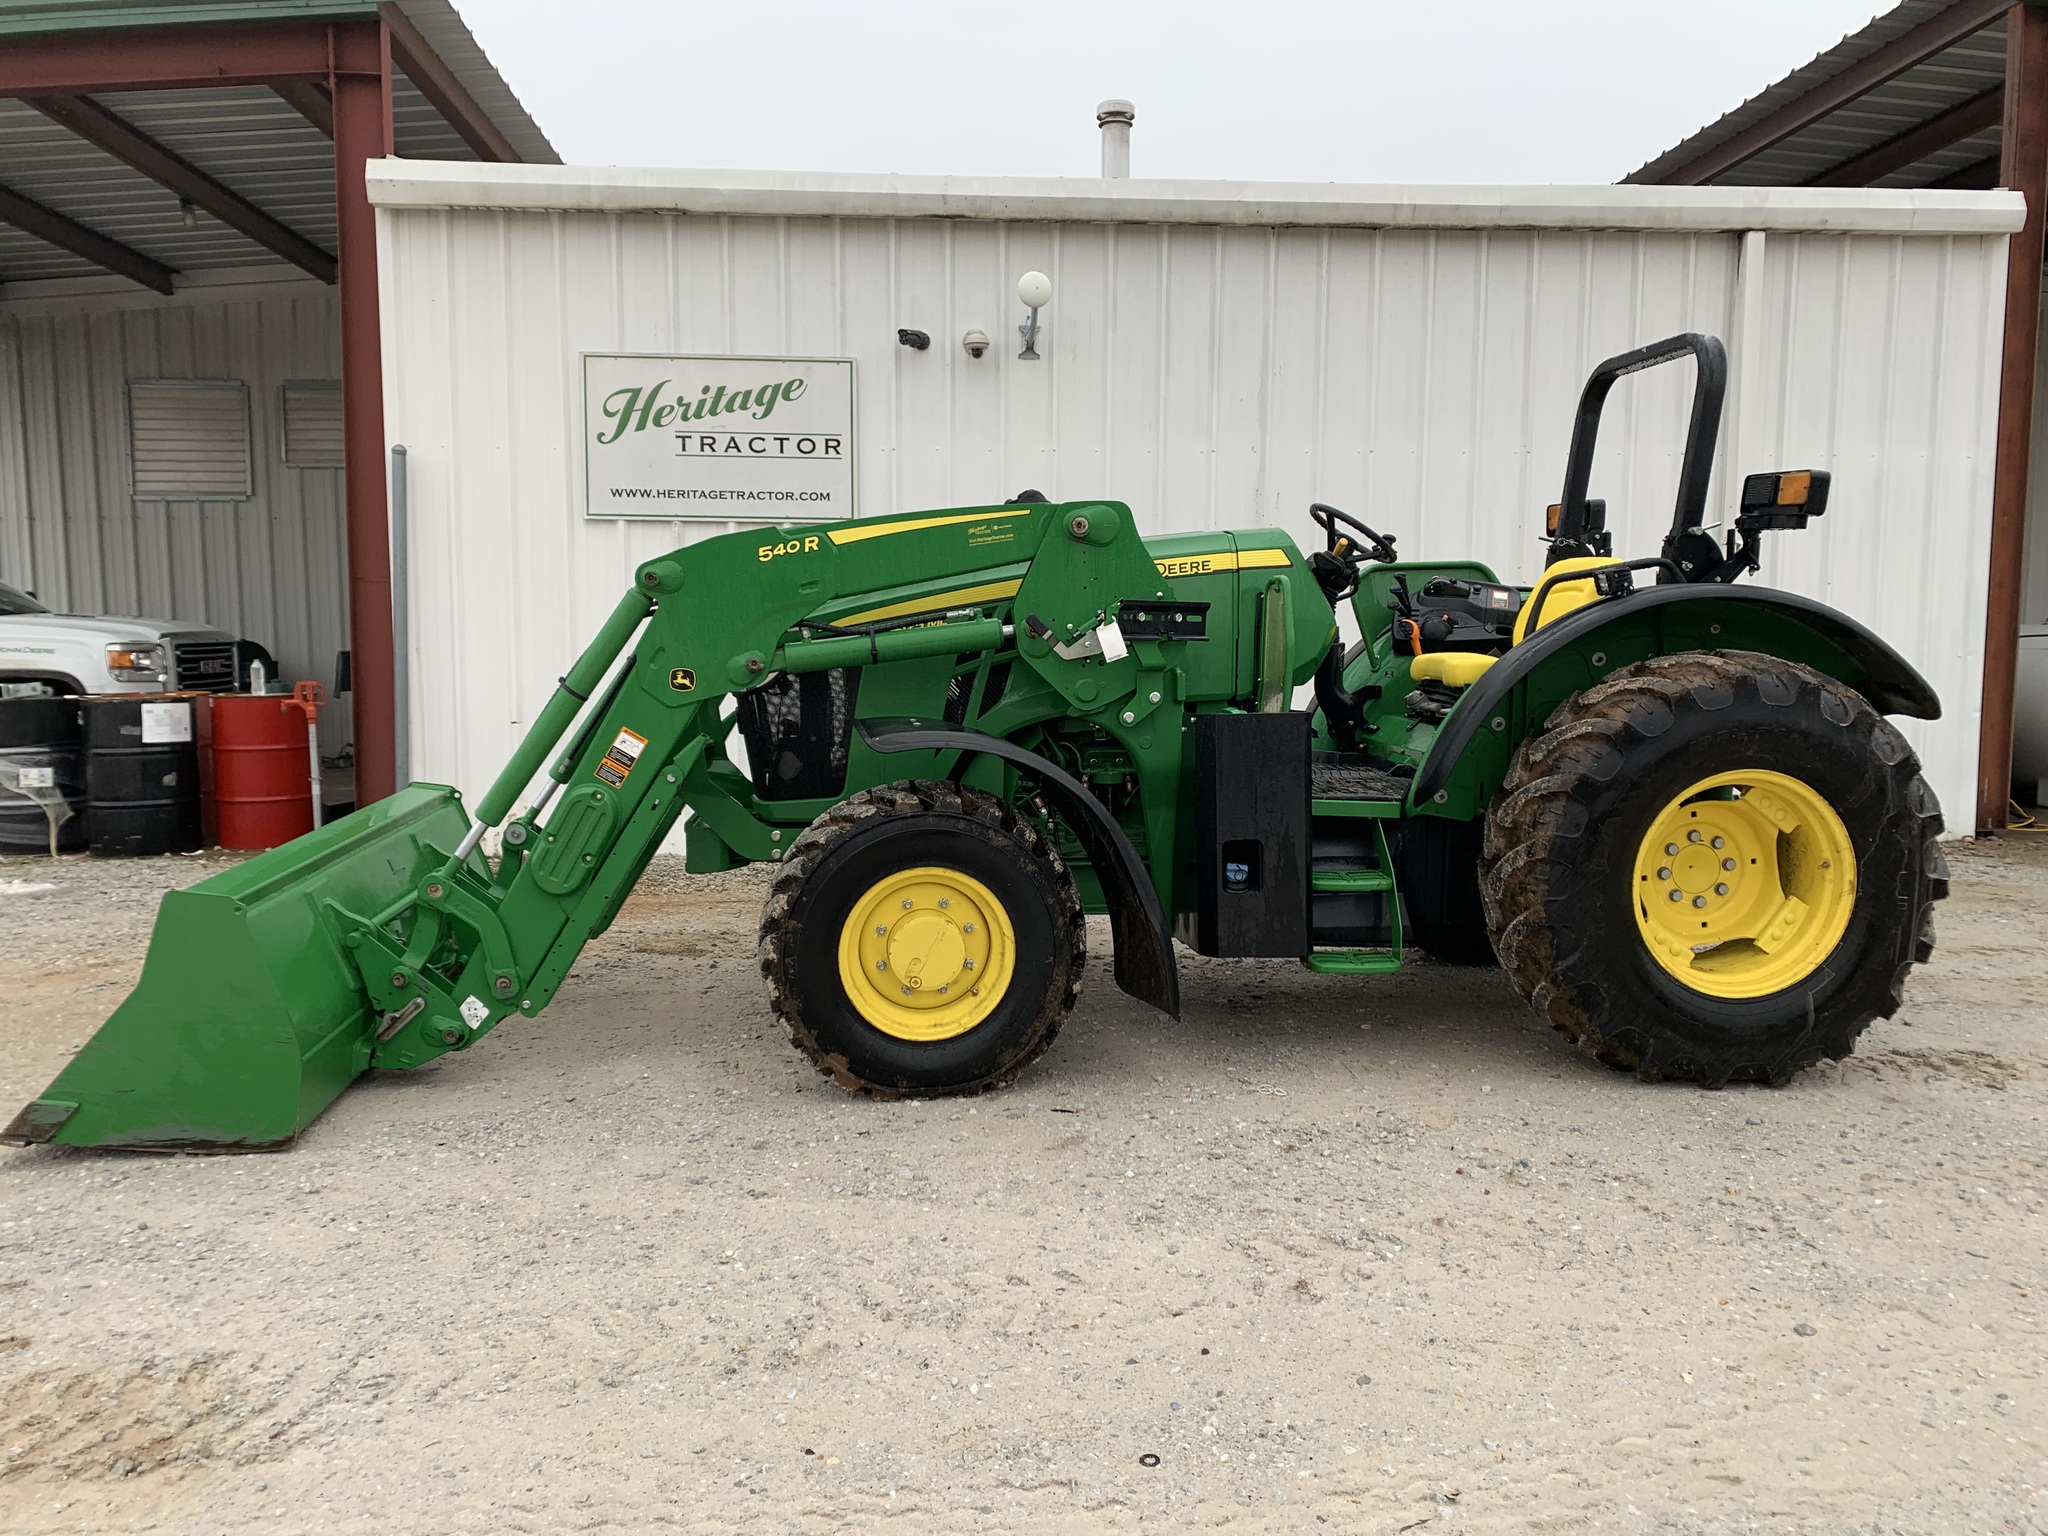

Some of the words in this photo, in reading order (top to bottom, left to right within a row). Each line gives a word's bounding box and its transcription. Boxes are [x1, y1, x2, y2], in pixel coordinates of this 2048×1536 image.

[596, 378, 808, 444] Heritage
[675, 435, 842, 455] TRACTOR
[610, 488, 831, 502] WWW.HERITAGETRACTOR.COM
[758, 540, 801, 562] 540
[804, 536, 820, 553] R
[1155, 560, 1211, 576] DEERE
[23, 646, 56, 654] DEERE
